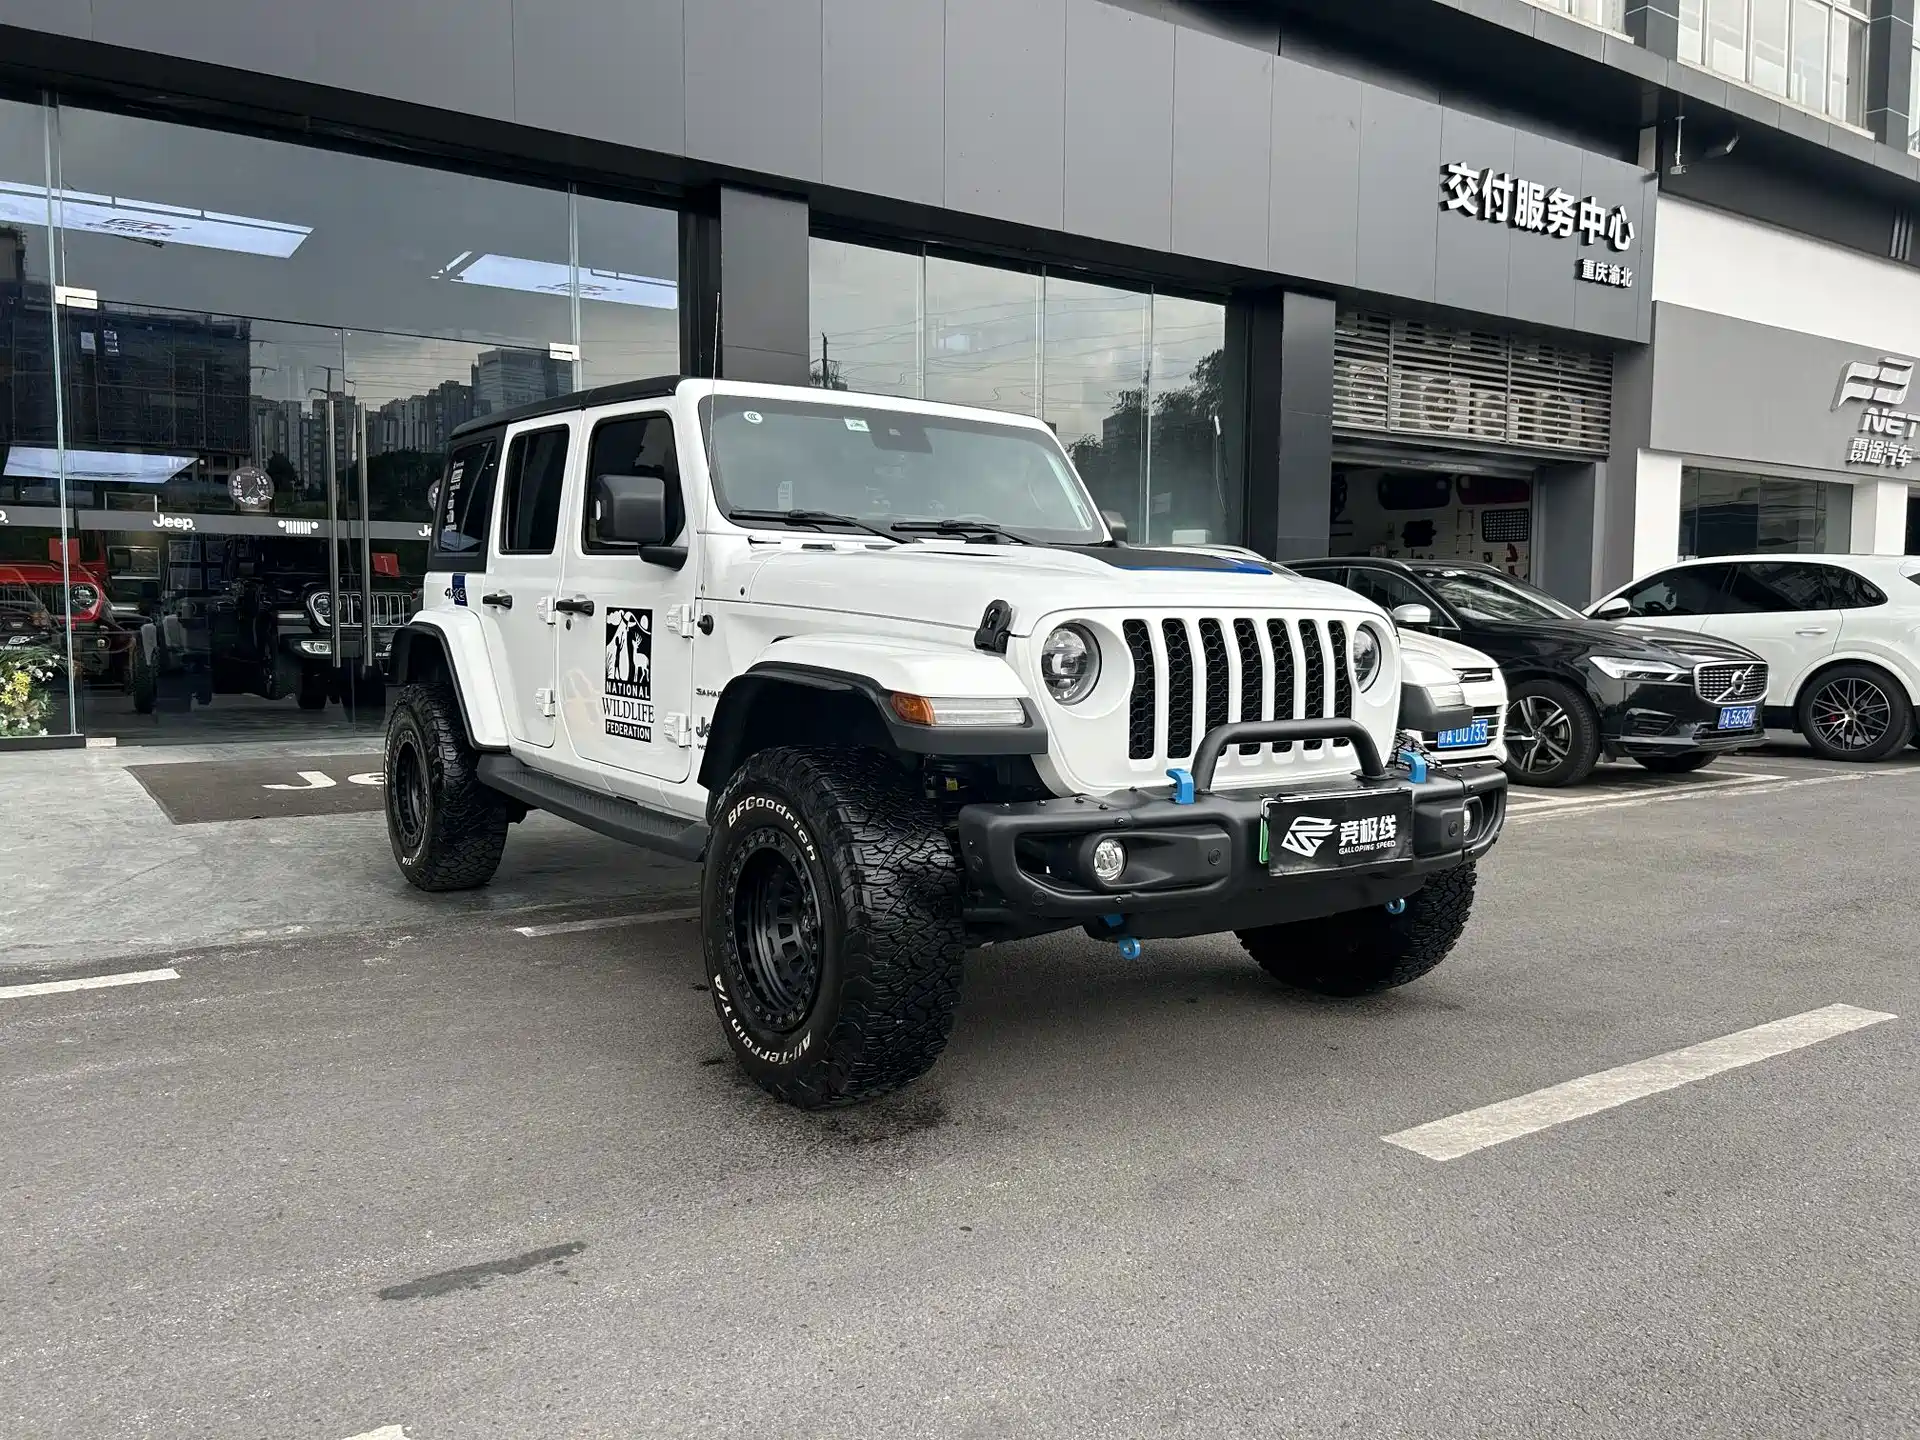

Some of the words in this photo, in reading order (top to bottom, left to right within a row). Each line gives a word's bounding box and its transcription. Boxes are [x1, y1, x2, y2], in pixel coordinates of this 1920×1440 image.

[1446, 161, 1636, 251] 交付服务中心
[1581, 258, 1633, 288] 重庆渝北
[606, 681, 650, 699] NATIONAL
[602, 697, 655, 724] WILDLIFE
[606, 720, 650, 740] FEDERATION
[727, 796, 817, 861] BFGoodrich
[1339, 815, 1397, 847] 竞极线
[1338, 843, 1375, 855] GALLOPING
[1375, 840, 1397, 850] SPEED
[713, 973, 732, 1017] T/A
